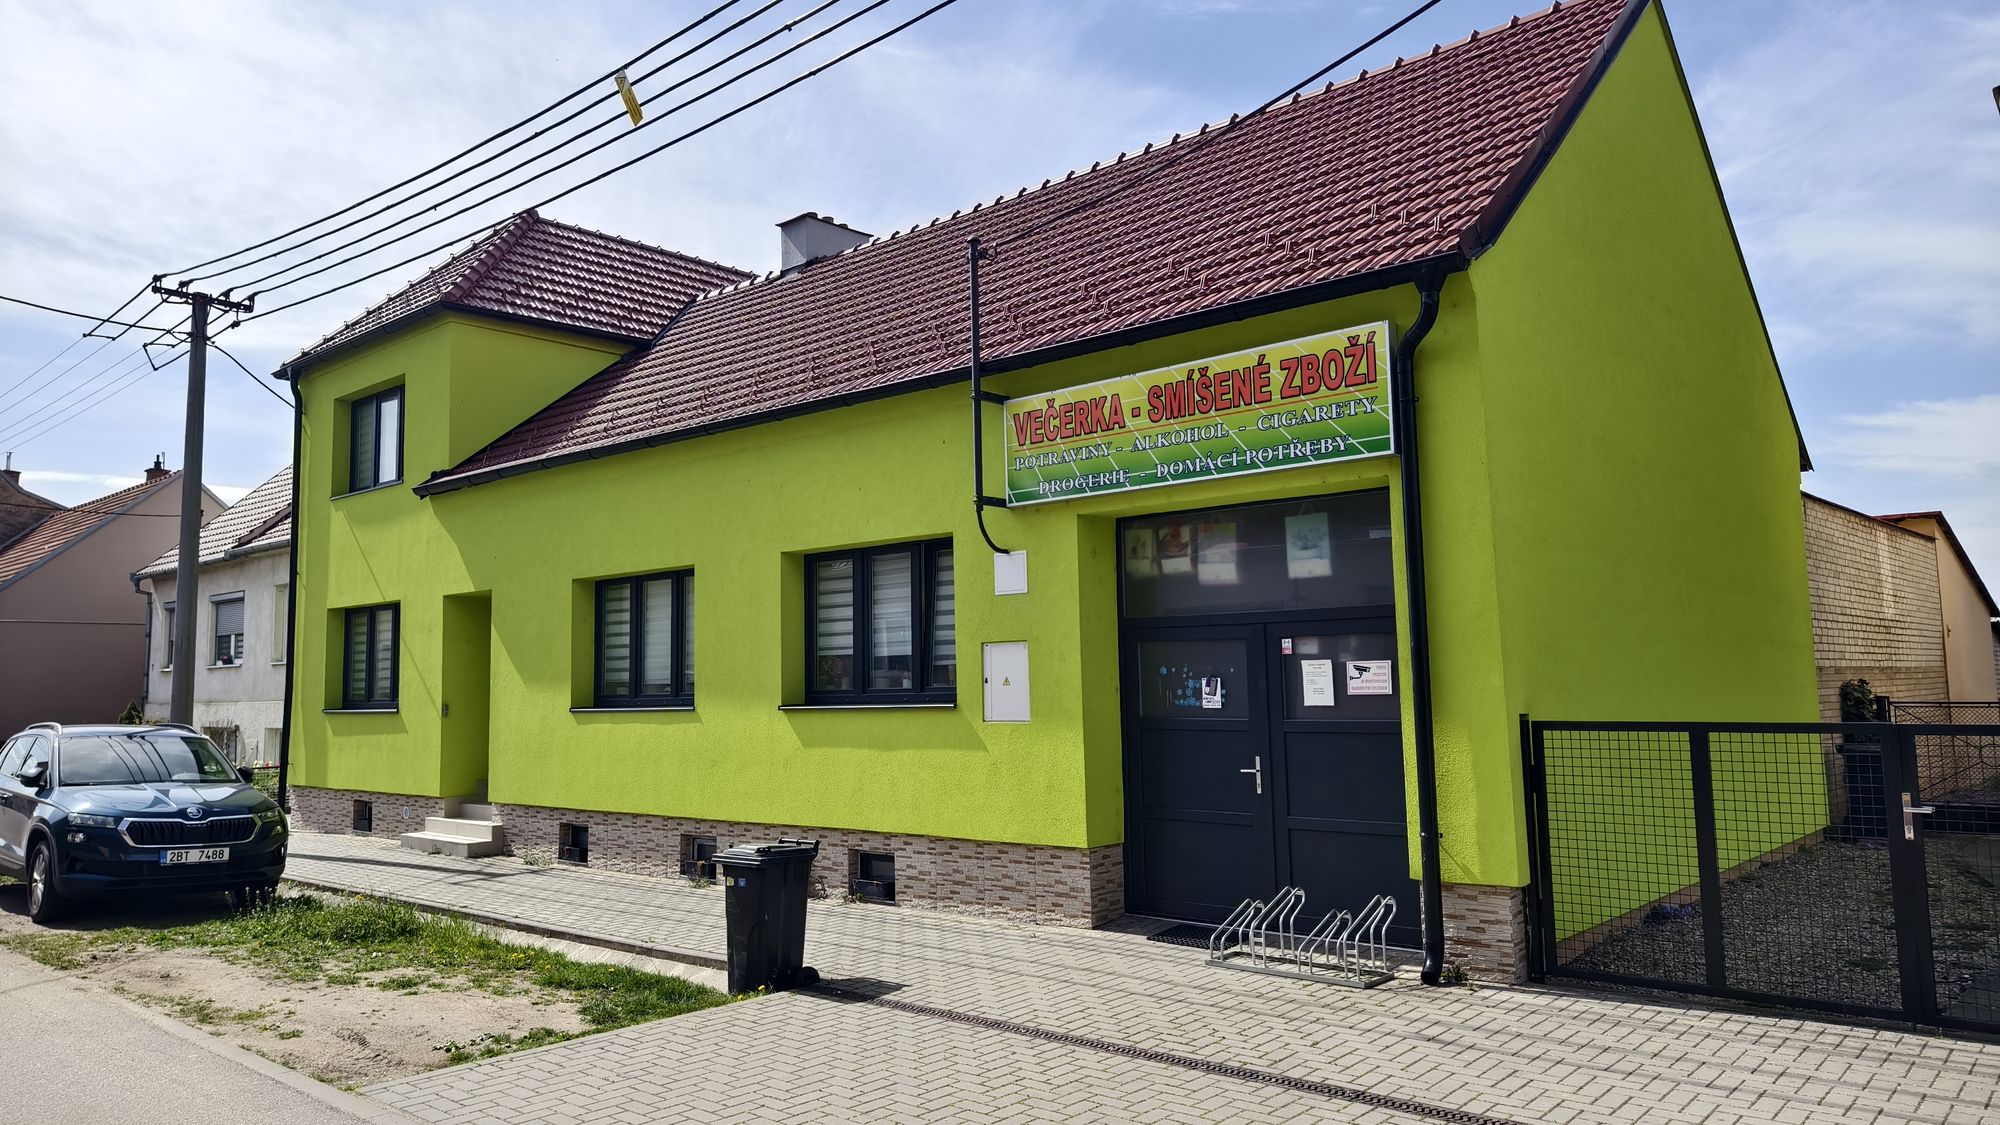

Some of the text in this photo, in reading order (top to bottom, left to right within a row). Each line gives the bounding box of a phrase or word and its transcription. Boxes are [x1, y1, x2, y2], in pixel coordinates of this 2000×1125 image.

[1013, 331, 1377, 446] VEČERKA - SMÍŠENÉ ZBOŽÍ
[1015, 442, 1112, 471] POTRAVINY
[1130, 422, 1229, 452] ALKOHOL
[1256, 396, 1378, 431] CIGARETY
[1038, 468, 1130, 495] DROGERIE
[1156, 448, 1238, 478] DOMÁCÍ
[1245, 434, 1352, 465] POTŘEBY
[169, 849, 225, 862] 2BT 7488
